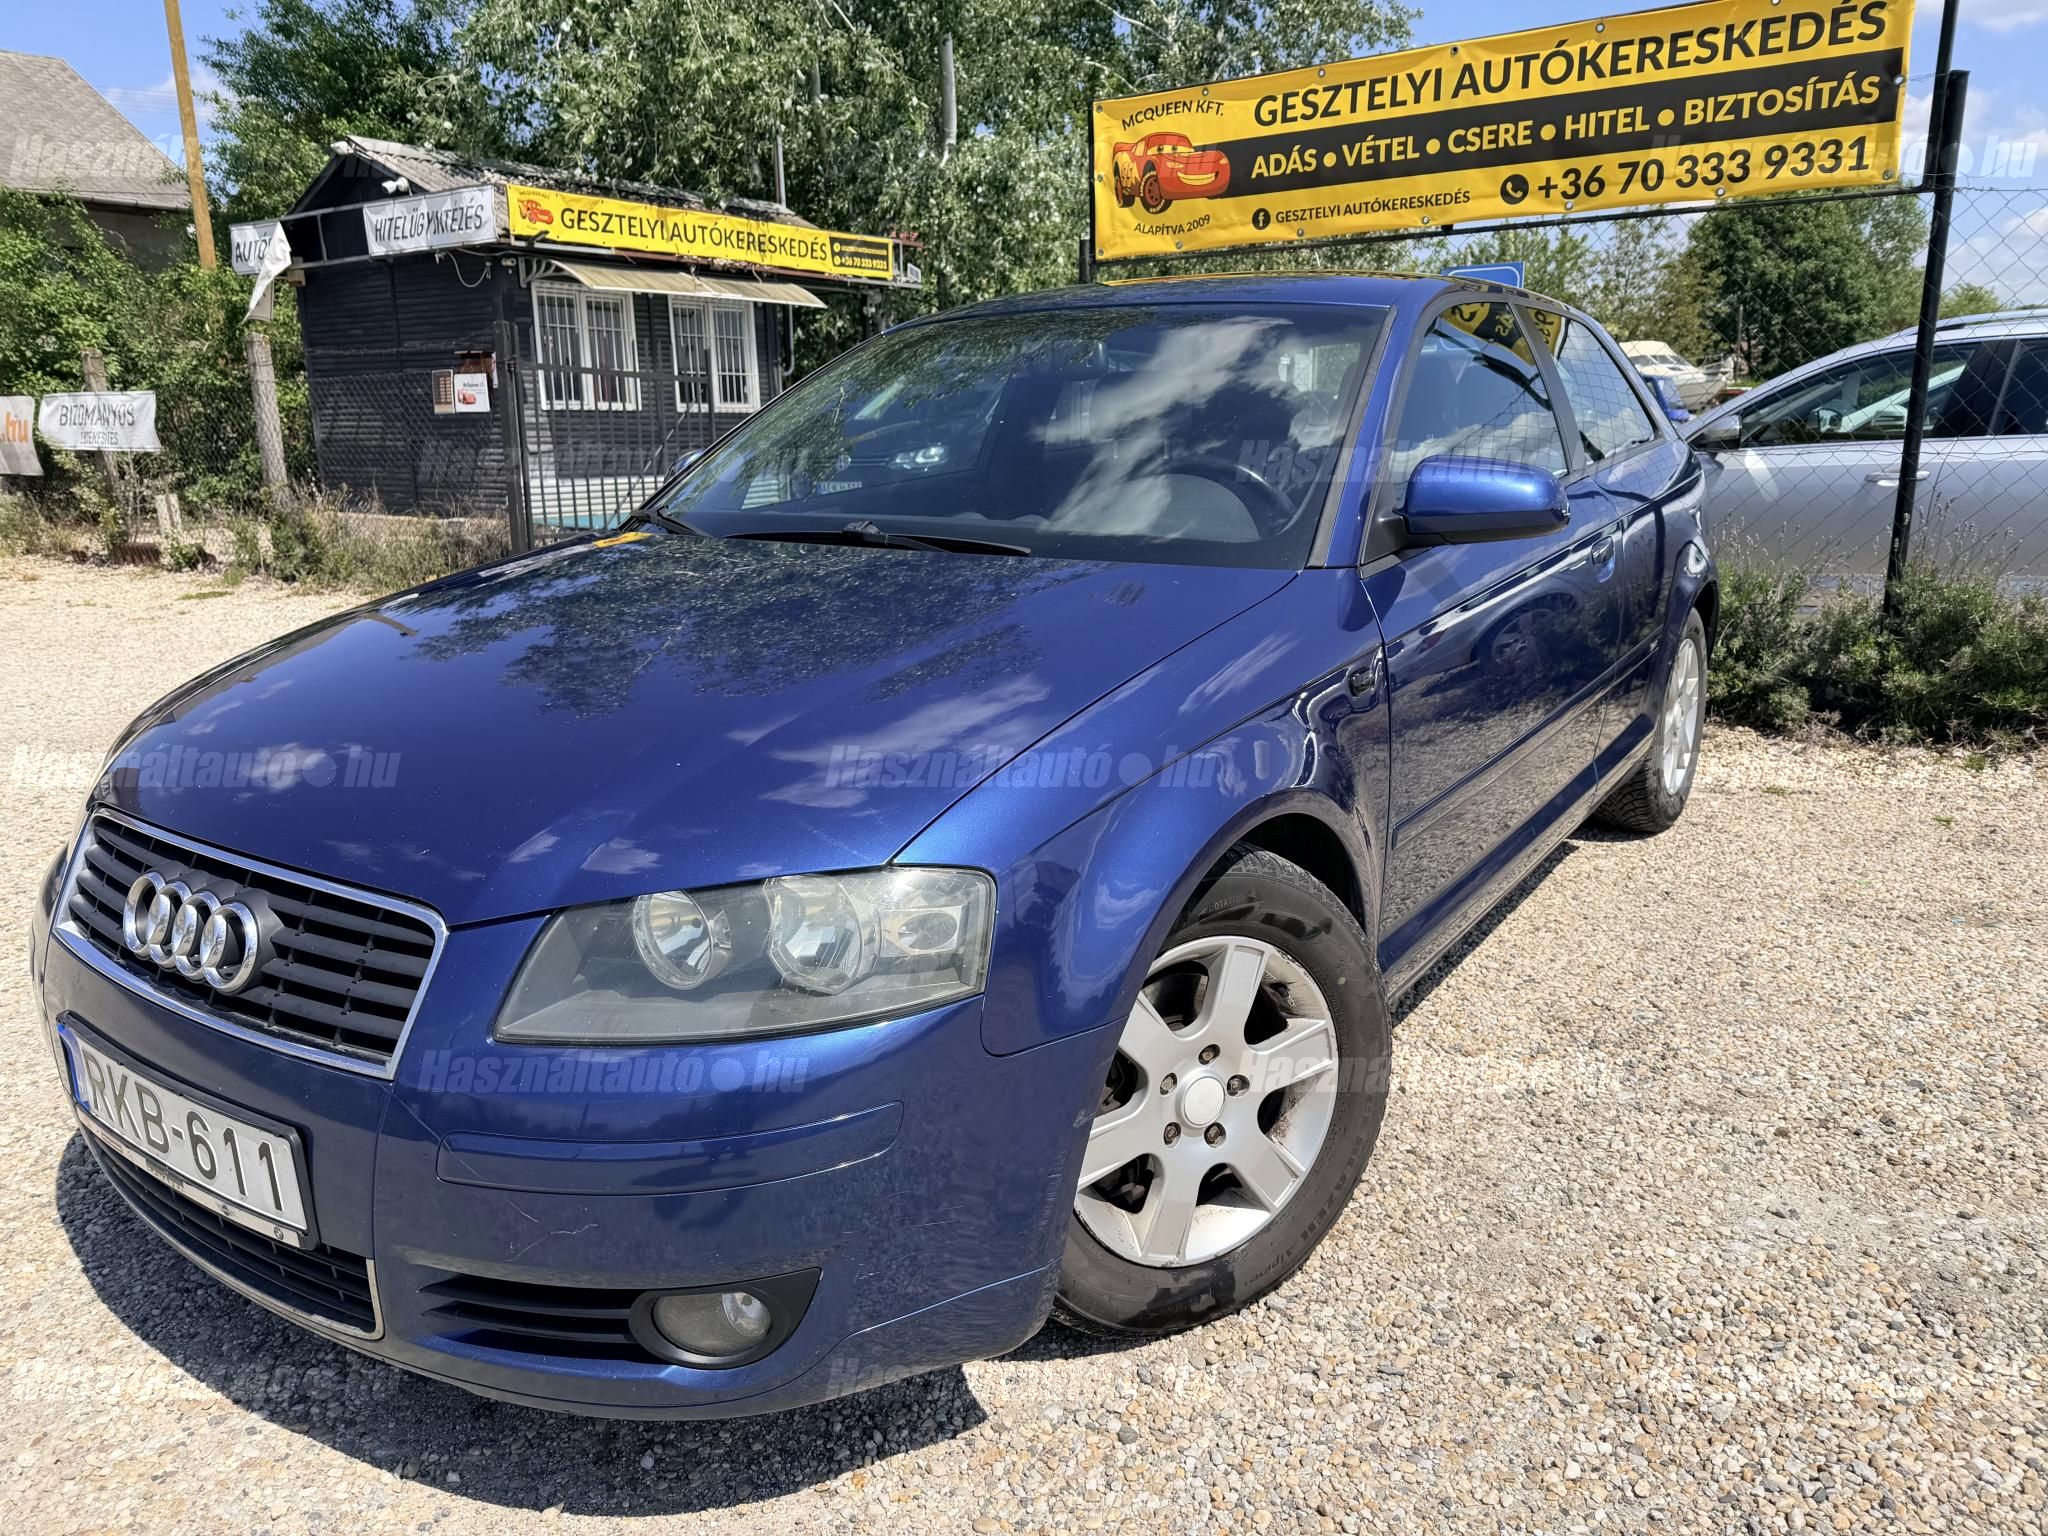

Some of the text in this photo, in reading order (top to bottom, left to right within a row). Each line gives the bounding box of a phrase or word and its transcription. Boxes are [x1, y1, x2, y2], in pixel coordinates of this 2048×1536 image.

[1253, 1, 1887, 127] GESZTELYI AUTÓKERESKEDÉS
[1121, 100, 1225, 131] MCQUEEN KFT.
[1251, 72, 1880, 179] ADÁS VÉTEL CSERE HITEL BIZTOSÍTÁS
[1537, 164, 1606, 200] +36
[1617, 158, 1663, 195] 70
[1676, 148, 1751, 187] 333
[1764, 136, 1870, 180] 9331
[375, 199, 485, 242] HITELÜGYINTÉZÉS
[1134, 213, 1211, 236] ALAPÍTVA 2009
[1275, 190, 1471, 223] GESZTELYI AUTÓKERESKEDÉS
[561, 207, 828, 261] GESZTELYI AUTÓKERESKEDÉS
[80, 1048, 284, 1213] RKB-611
